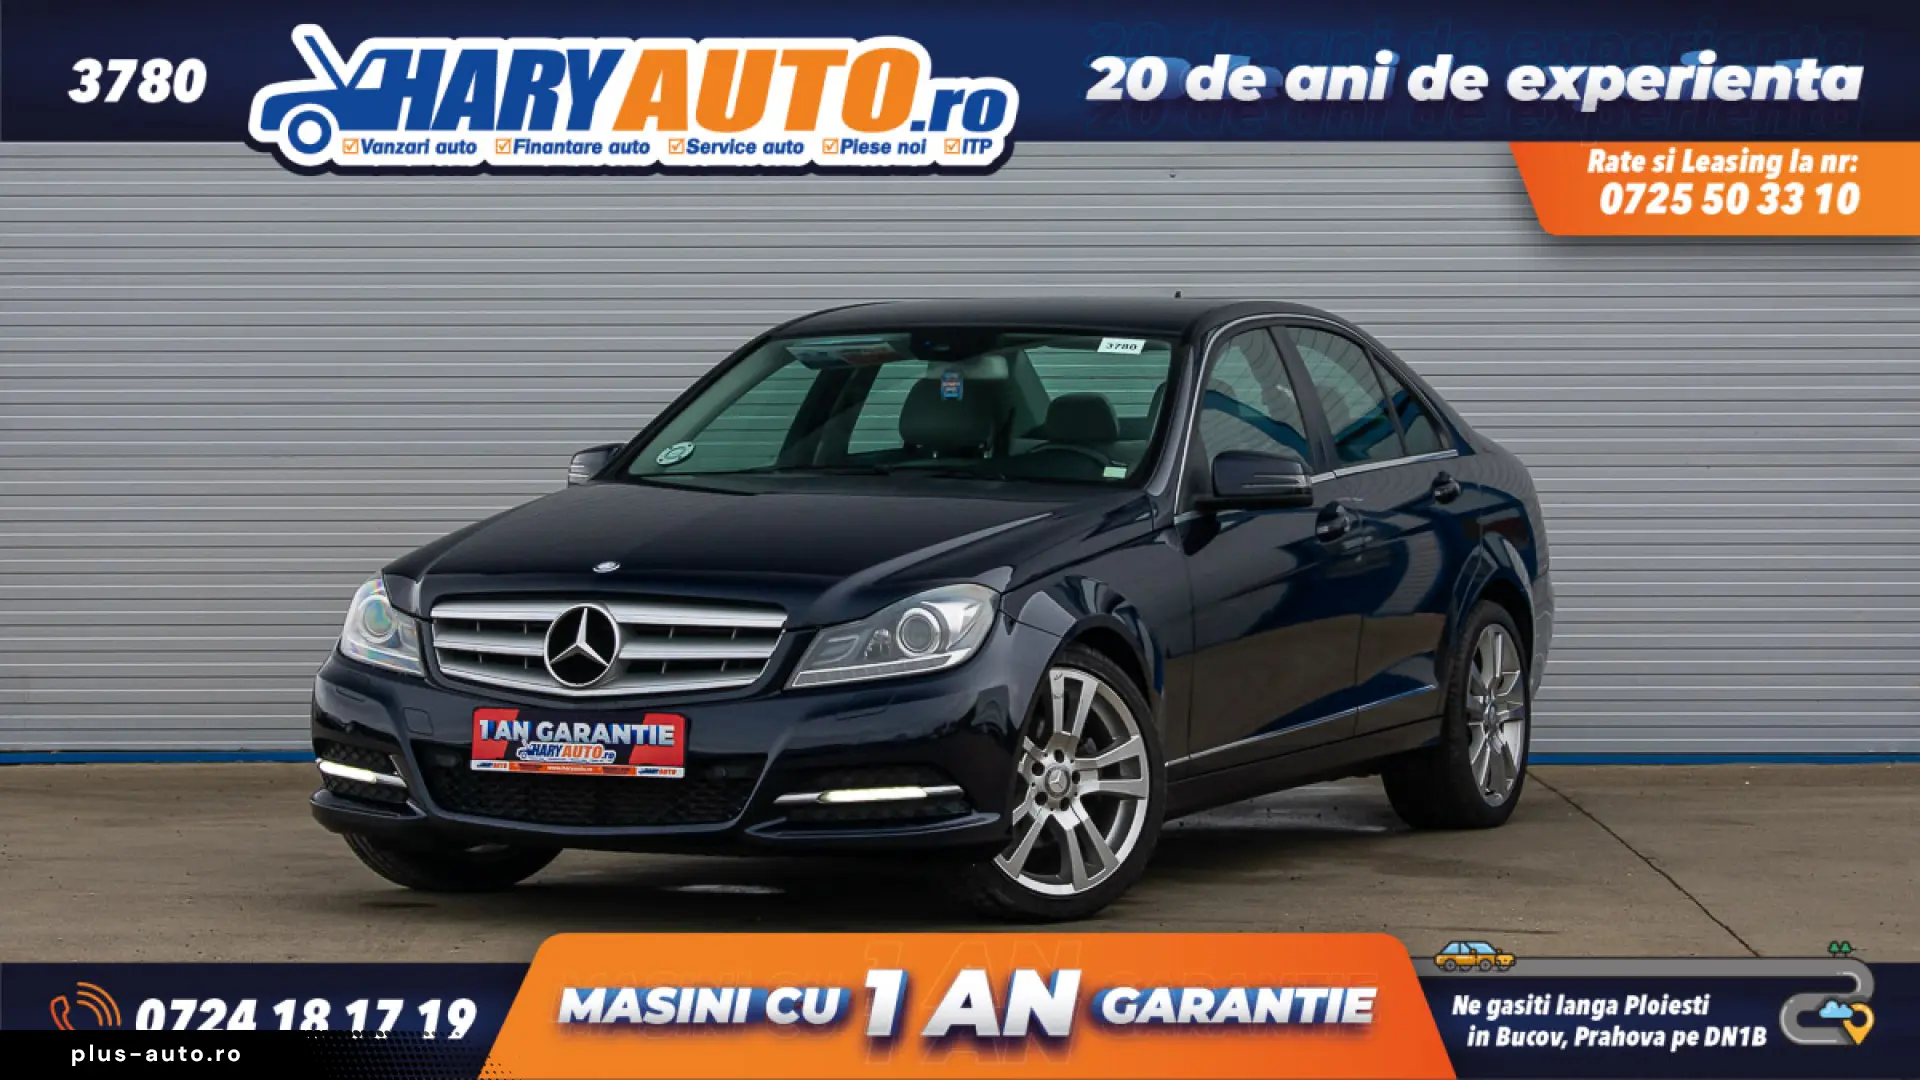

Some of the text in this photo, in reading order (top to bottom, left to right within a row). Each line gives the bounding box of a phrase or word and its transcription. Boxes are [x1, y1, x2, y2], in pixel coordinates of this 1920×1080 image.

[479, 719, 675, 746] 1 AN GARANTIE
